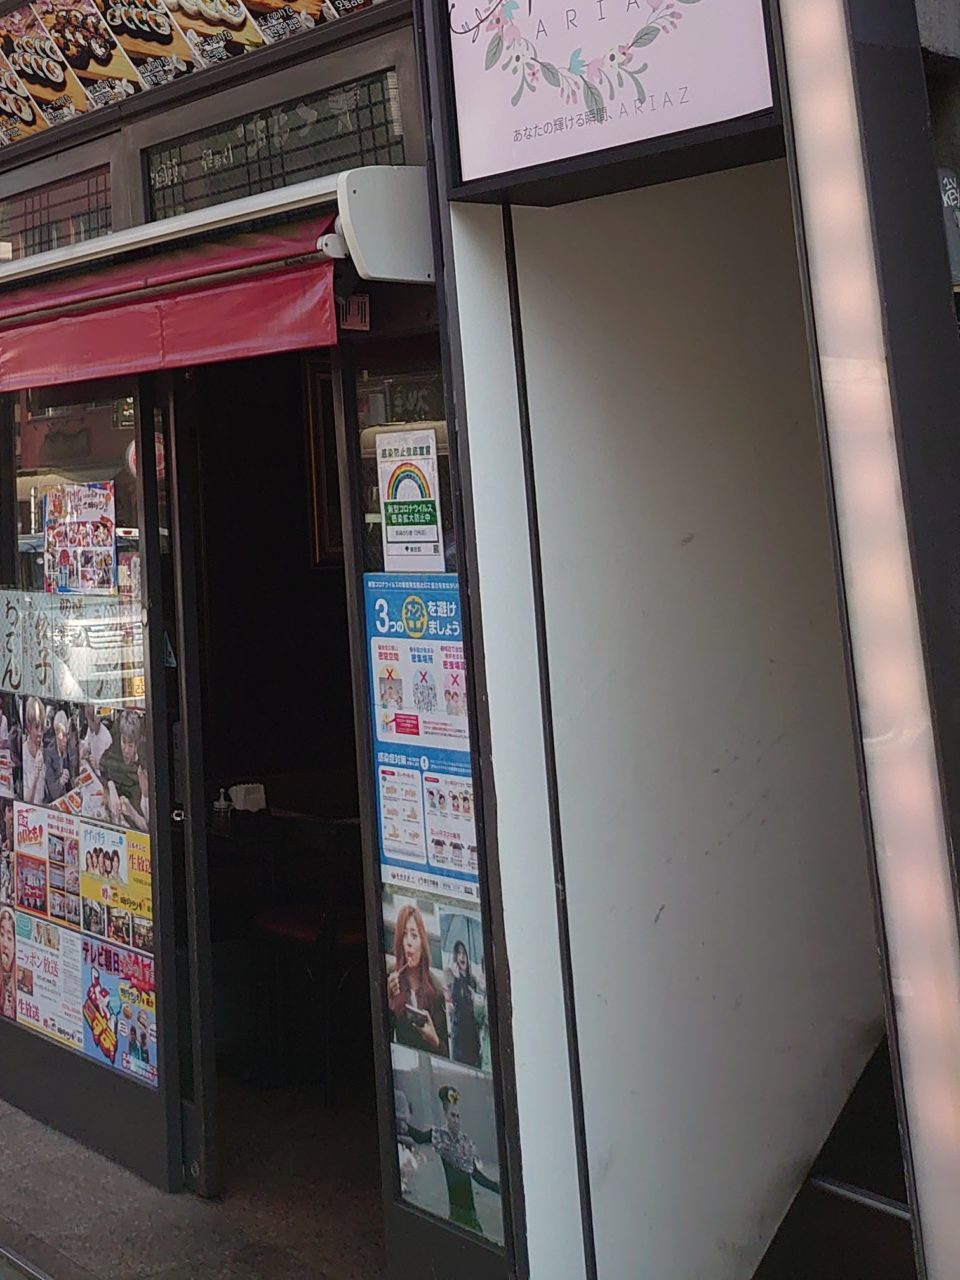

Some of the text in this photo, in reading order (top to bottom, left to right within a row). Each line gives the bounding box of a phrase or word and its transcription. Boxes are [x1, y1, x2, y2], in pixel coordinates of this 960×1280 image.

[387, 504, 433, 513] 新型コロナウイルス
